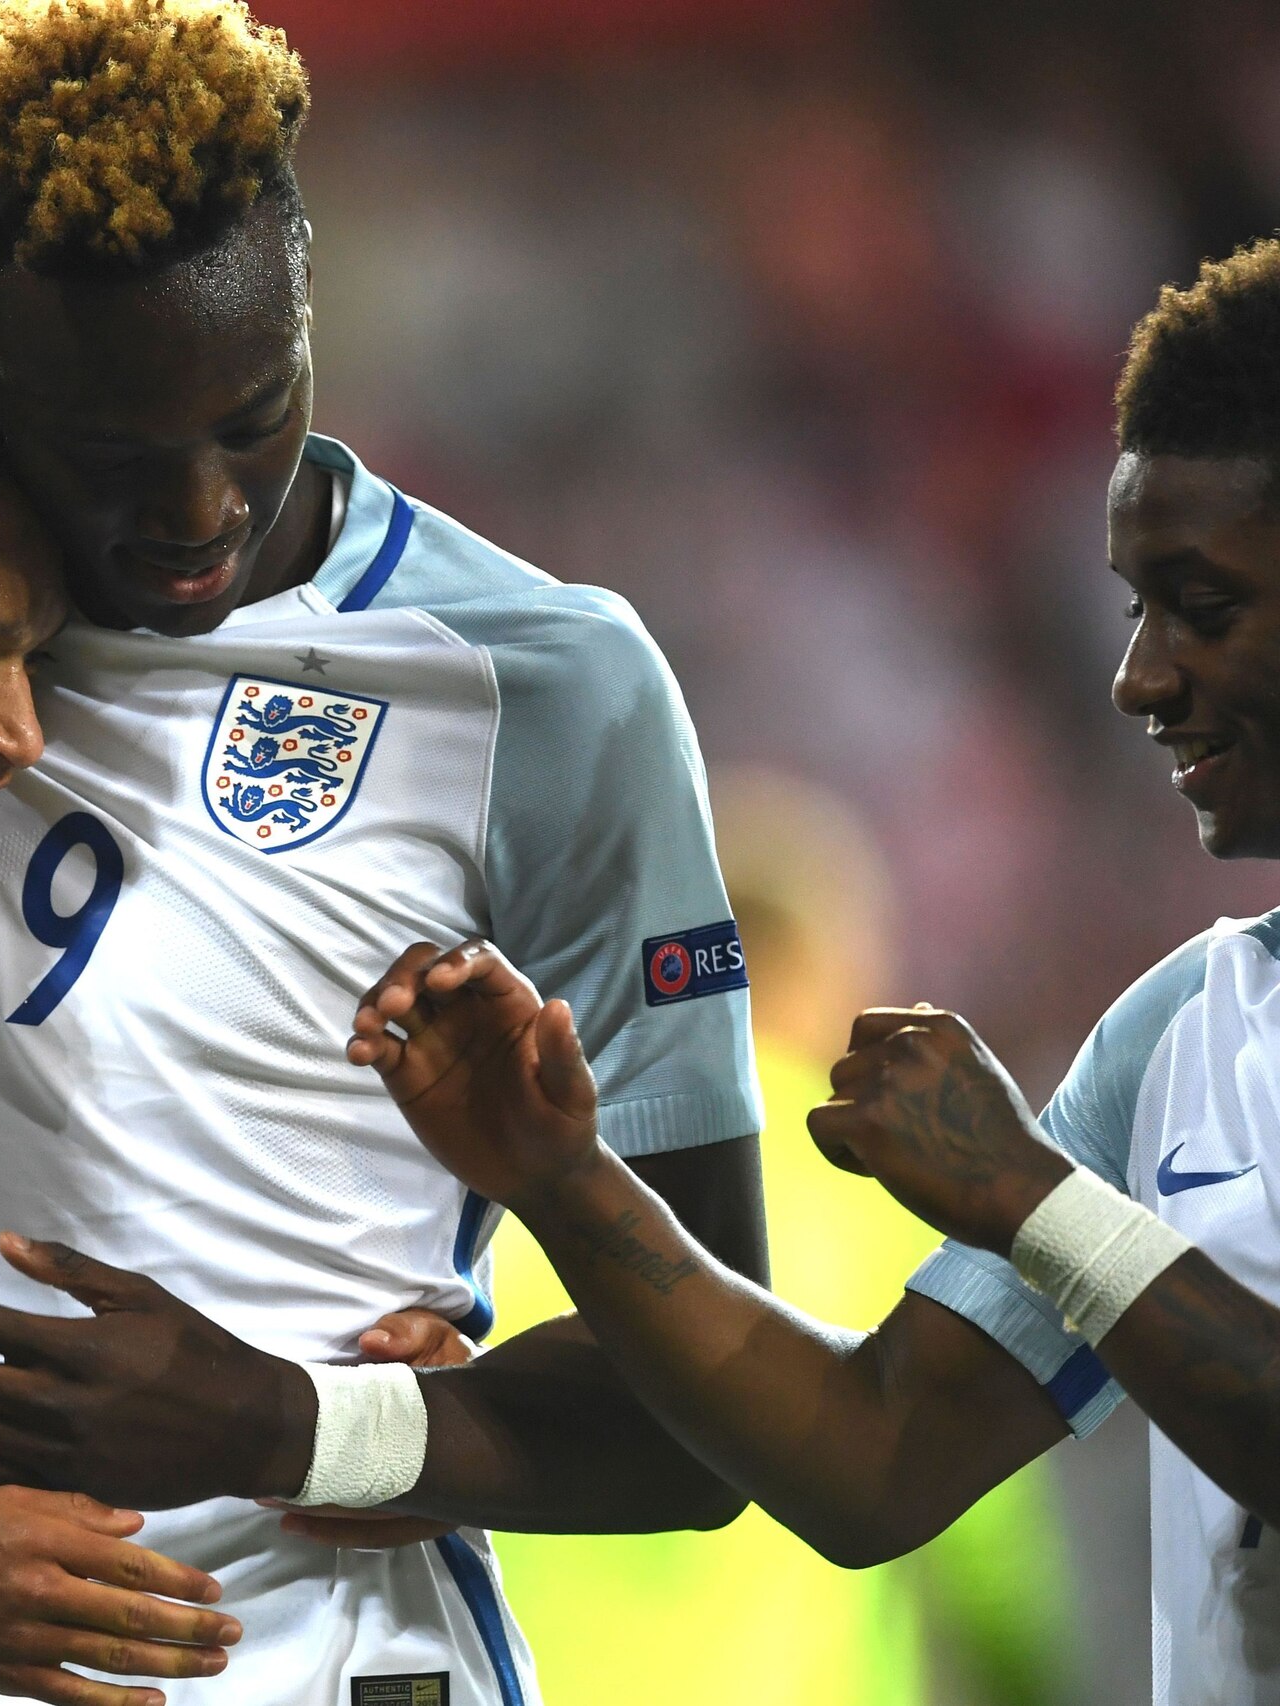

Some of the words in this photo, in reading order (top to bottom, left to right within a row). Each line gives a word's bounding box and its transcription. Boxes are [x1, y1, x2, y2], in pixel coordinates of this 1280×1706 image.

[5, 811, 124, 1026] 9
[658, 945, 682, 959] UEFA
[695, 940, 743, 976] RES
[363, 1685, 410, 1694] AUTHENTIC
